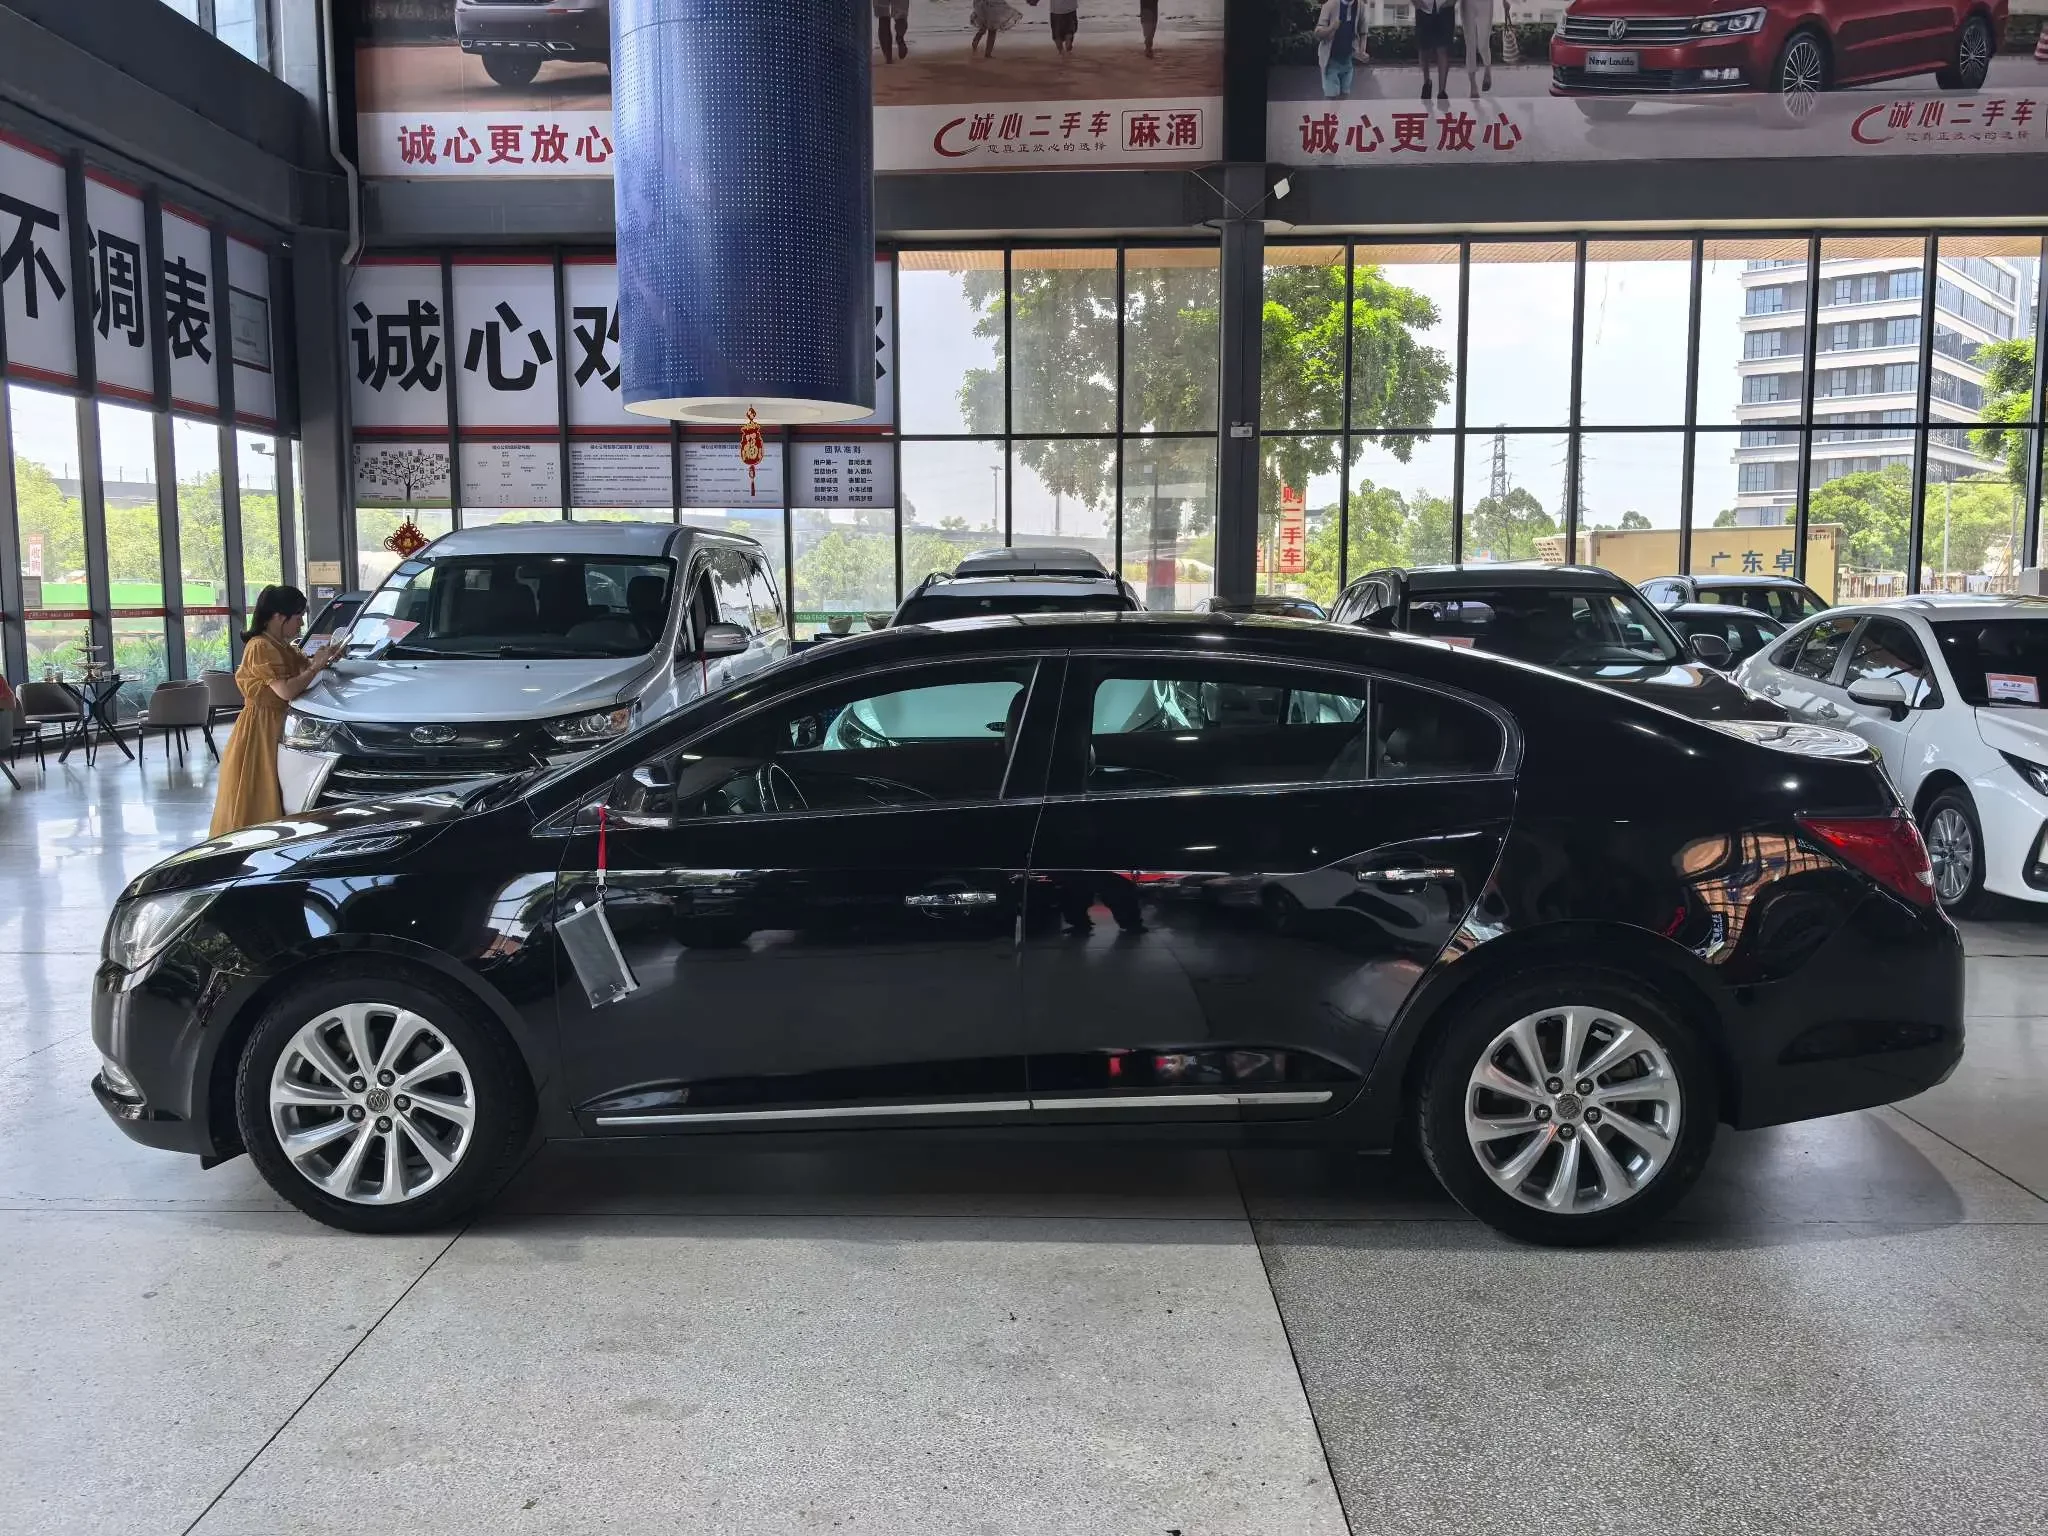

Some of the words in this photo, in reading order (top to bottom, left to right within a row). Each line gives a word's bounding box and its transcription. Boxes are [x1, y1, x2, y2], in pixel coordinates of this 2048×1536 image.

[968, 110, 1112, 141] 诚心二手车
[1128, 112, 1198, 148] 麻涌
[1887, 98, 2037, 129] 诚心二手车
[397, 123, 615, 165] 诚心更放心
[1299, 111, 1522, 154] 诚心更放心
[1711, 548, 1795, 573] 广东卓
